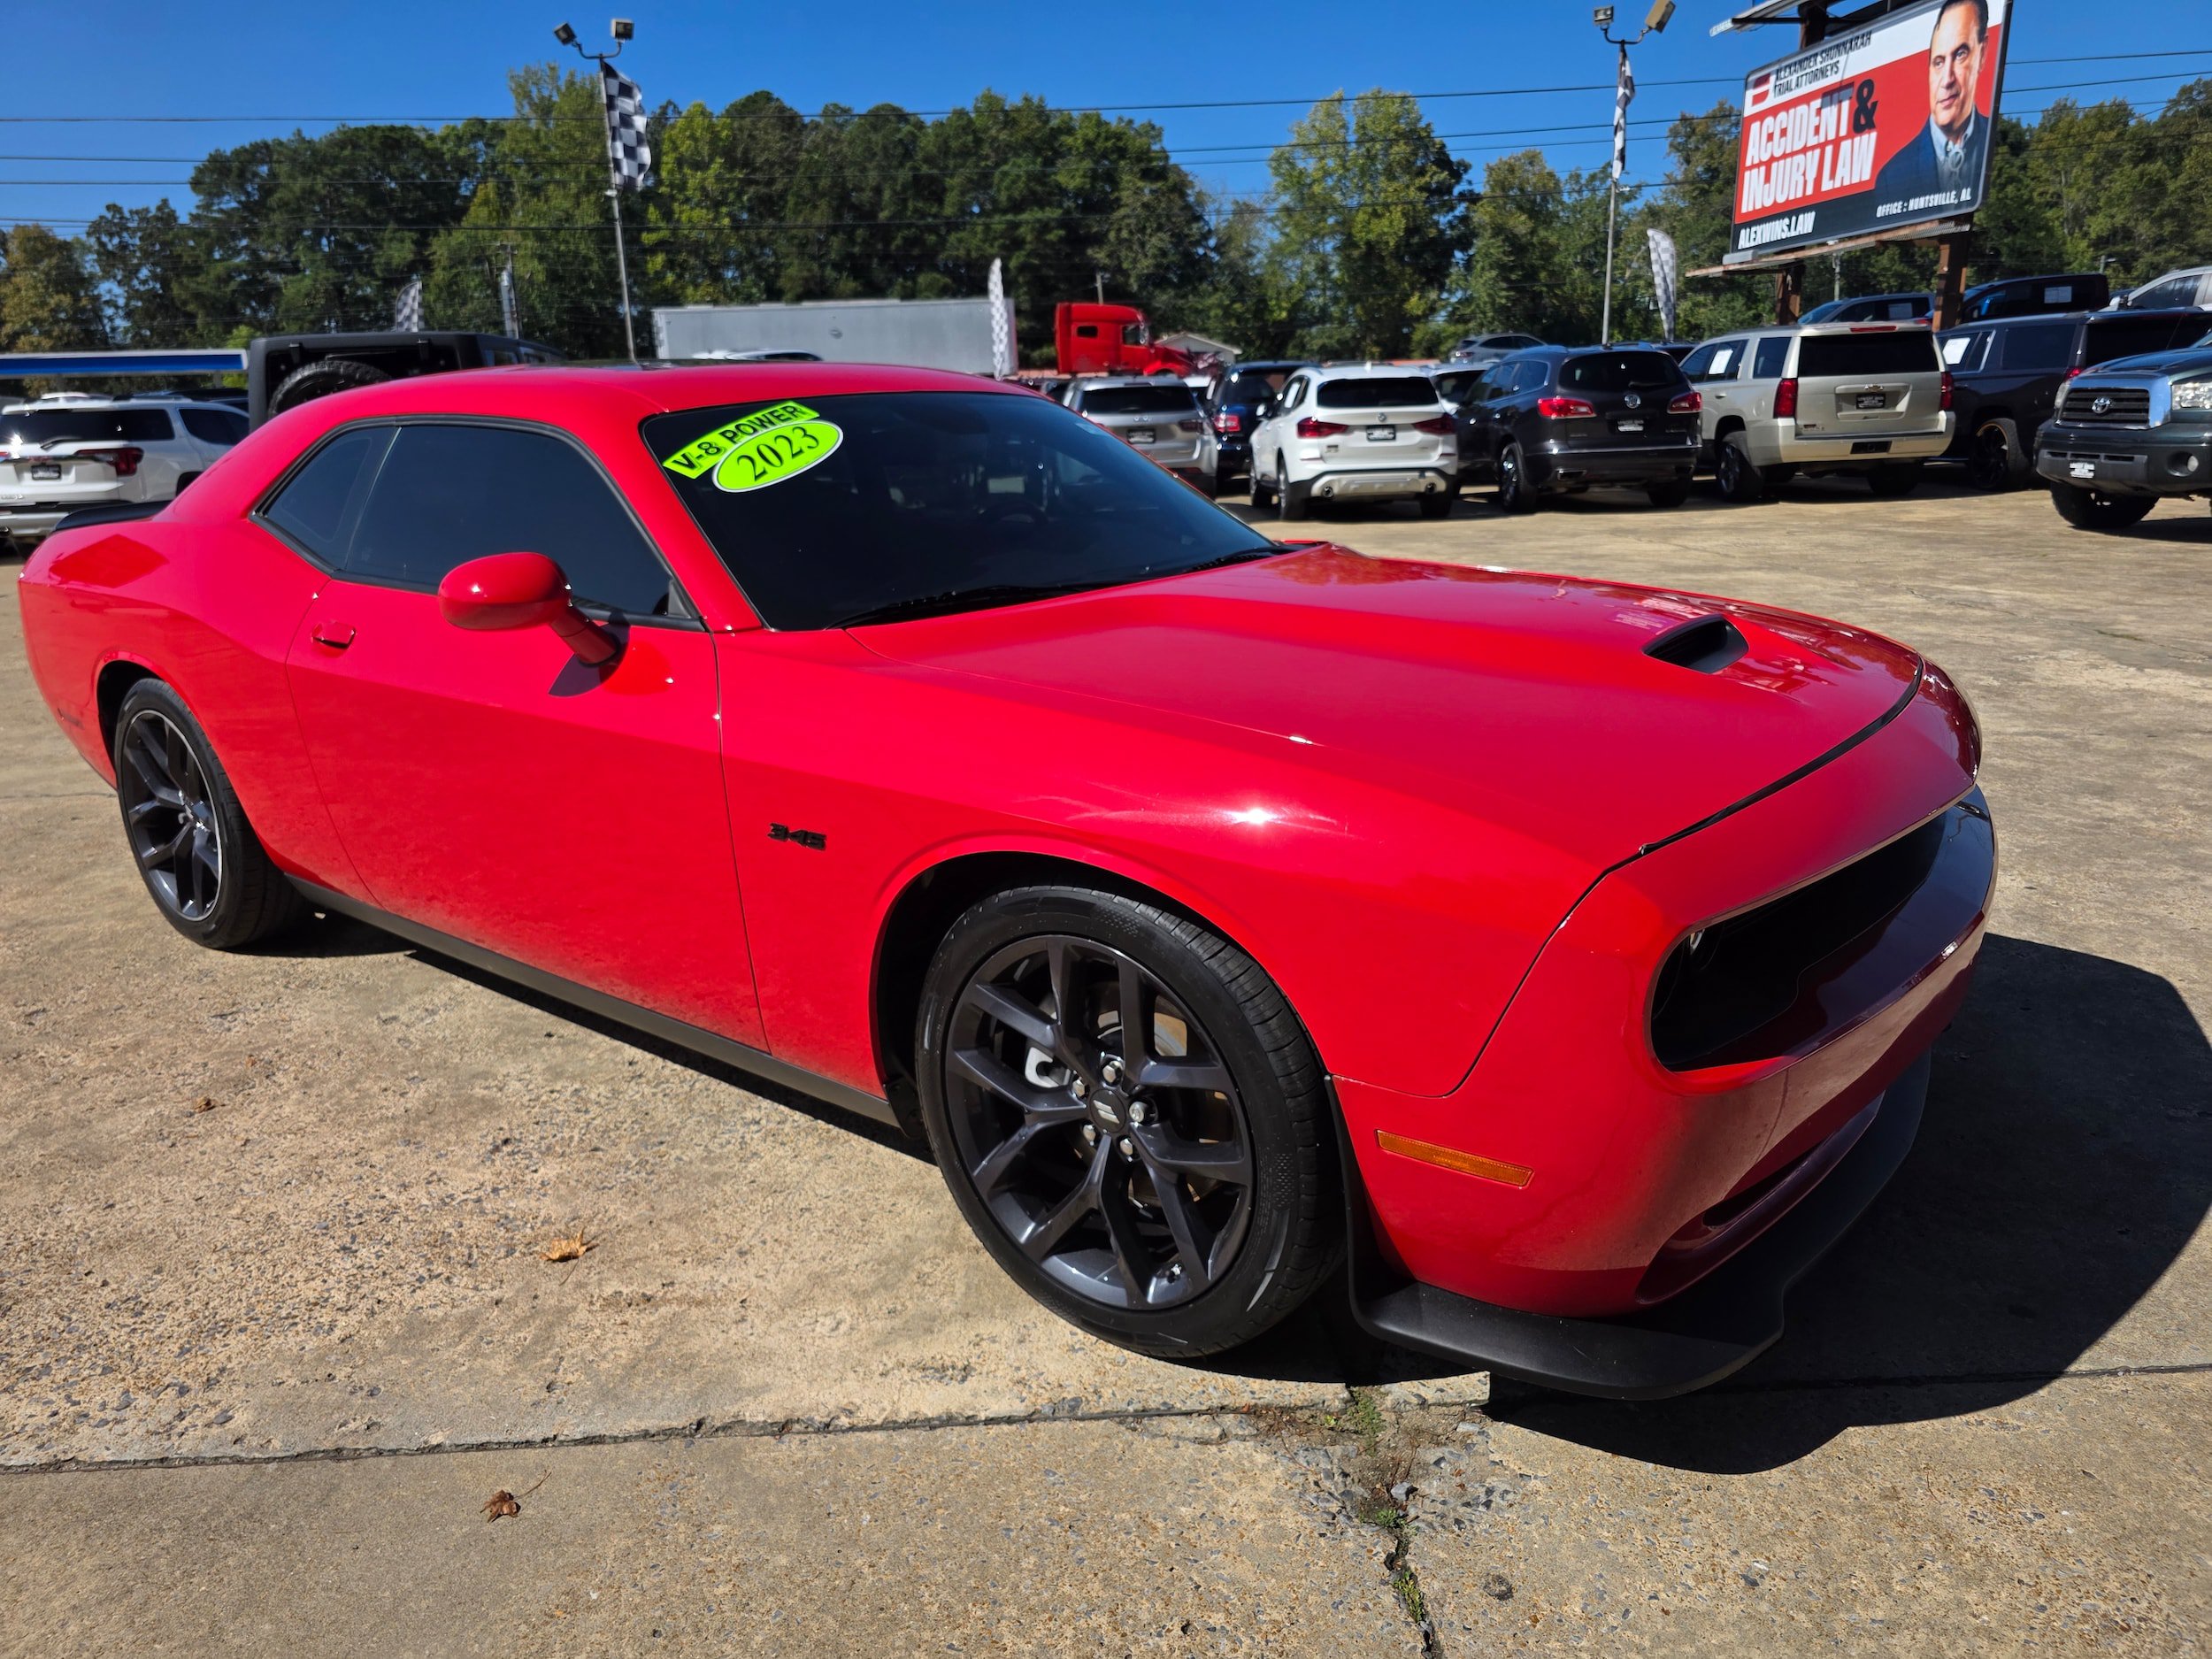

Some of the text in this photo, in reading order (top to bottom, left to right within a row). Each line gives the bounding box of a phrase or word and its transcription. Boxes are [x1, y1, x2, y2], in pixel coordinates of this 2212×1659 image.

[1773, 59, 1839, 97] TRIAL ATTORNEYS
[1775, 51, 1818, 82] ALEXANDER
[1745, 79, 1878, 167] ACCIDENT &
[1741, 131, 1878, 213] INJURY LAW
[1908, 190, 1958, 211] HUNTSVILLE,
[1959, 187, 1971, 202] AL
[1738, 211, 1816, 250] ALEXWINS.LAW
[672, 405, 807, 470] V-8 POWER
[736, 426, 820, 481] 2023
[767, 822, 828, 851] 345
